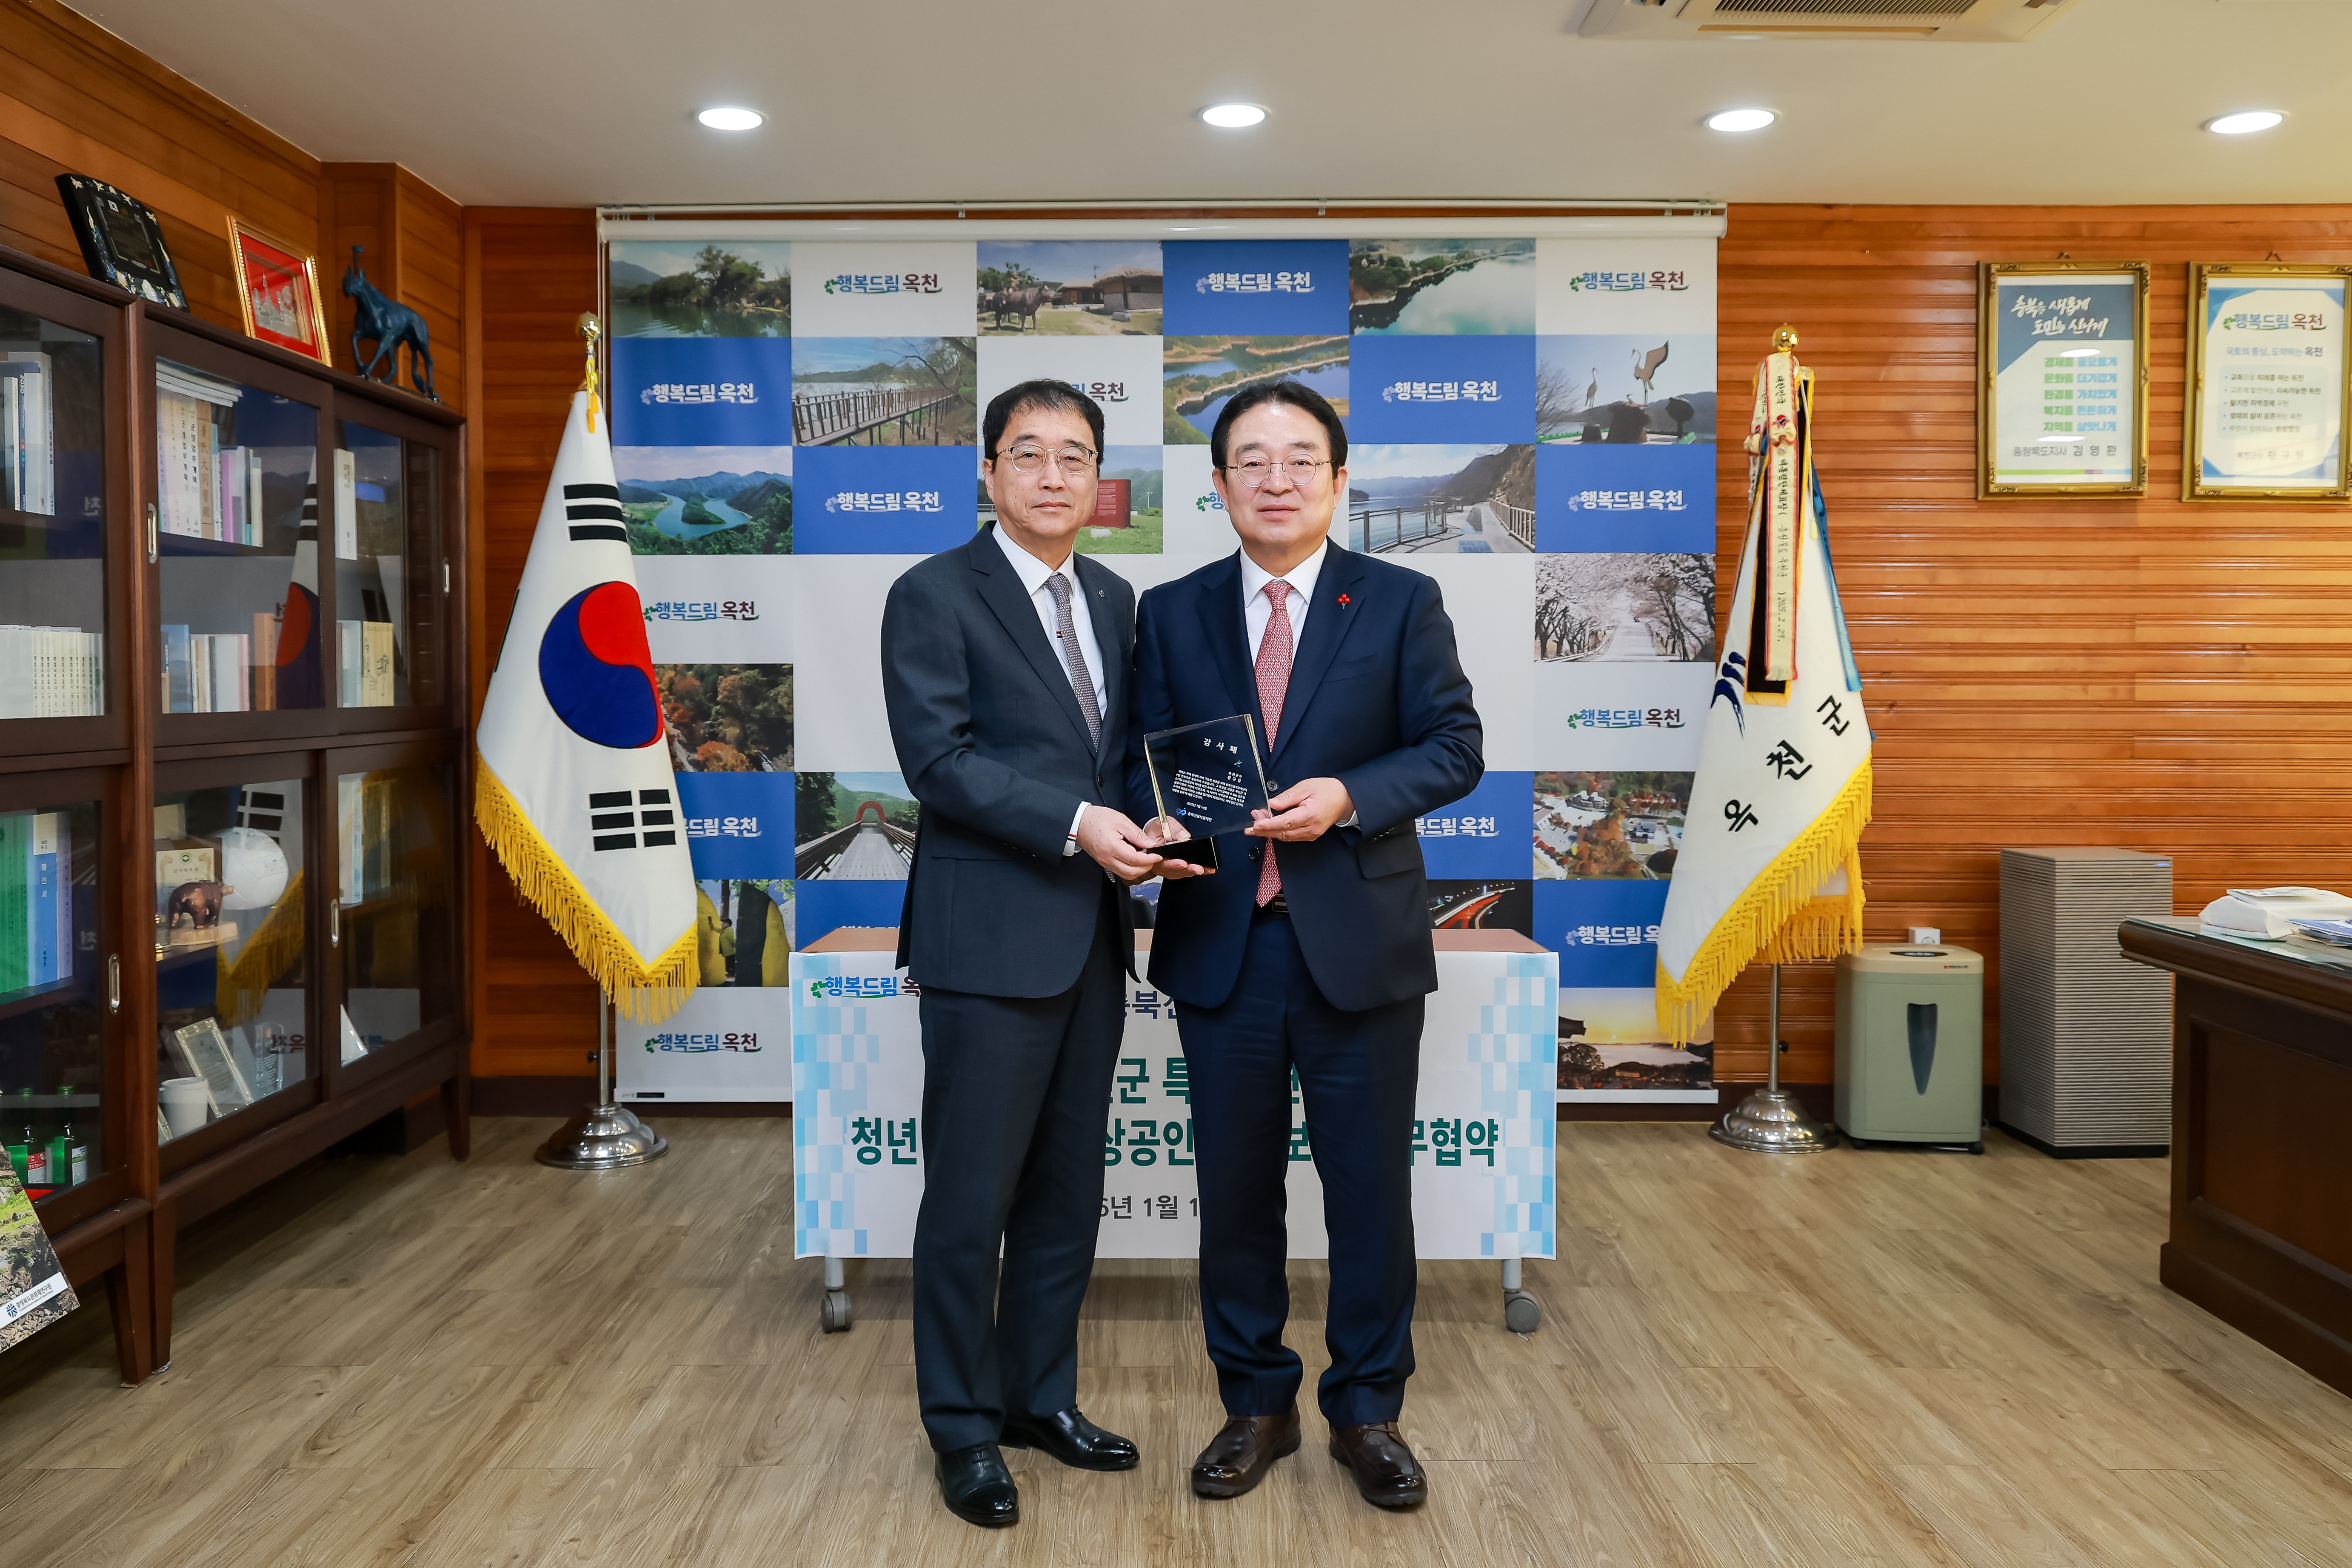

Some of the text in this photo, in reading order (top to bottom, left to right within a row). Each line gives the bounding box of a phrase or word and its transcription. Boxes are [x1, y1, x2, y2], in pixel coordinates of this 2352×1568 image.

[836, 273, 938, 293] 행복드림 옥천
[1208, 272, 1311, 293] 행복드림 옥천
[1582, 271, 1684, 291] 행복드림 옥천
[2048, 296, 2092, 317] 새롭게
[2068, 317, 2109, 338] 신나게
[2235, 314, 2323, 330] 행복드림 옥천
[2045, 357, 2073, 367] 경제를
[2305, 347, 2323, 357] 옥천
[652, 383, 754, 403] 행복드림 옥천
[1089, 383, 1125, 402] 옥천
[1394, 380, 1498, 401] 행복드림 옥천
[1775, 375, 1786, 404] 대한민국
[2044, 406, 2073, 415] 복지를
[2044, 422, 2072, 431] 지역을
[2014, 447, 2067, 456] 충청북도지사
[836, 491, 940, 512] 행복드림 옥천
[1580, 490, 1683, 510] 행복드림 옥천
[655, 601, 755, 620] 행복드림 옥천
[1580, 708, 1681, 728] 행복드림 옥천
[721, 817, 757, 837] 옥천
[1187, 812, 1212, 822] 충북신용보증재단
[1459, 817, 1495, 836] 옥천
[1578, 925, 1660, 944] 행복드림 옥
[825, 976, 920, 997] 행복드림 옥
[657, 1033, 757, 1052] 행복드림 옥천
[1110, 1057, 1190, 1104] 군 특
[851, 1117, 916, 1165] 청년
[1143, 1195, 1178, 1220] 1월
[1189, 1197, 1198, 1217] 1
[16, 1283, 52, 1308] 충청북도문화재연구원
